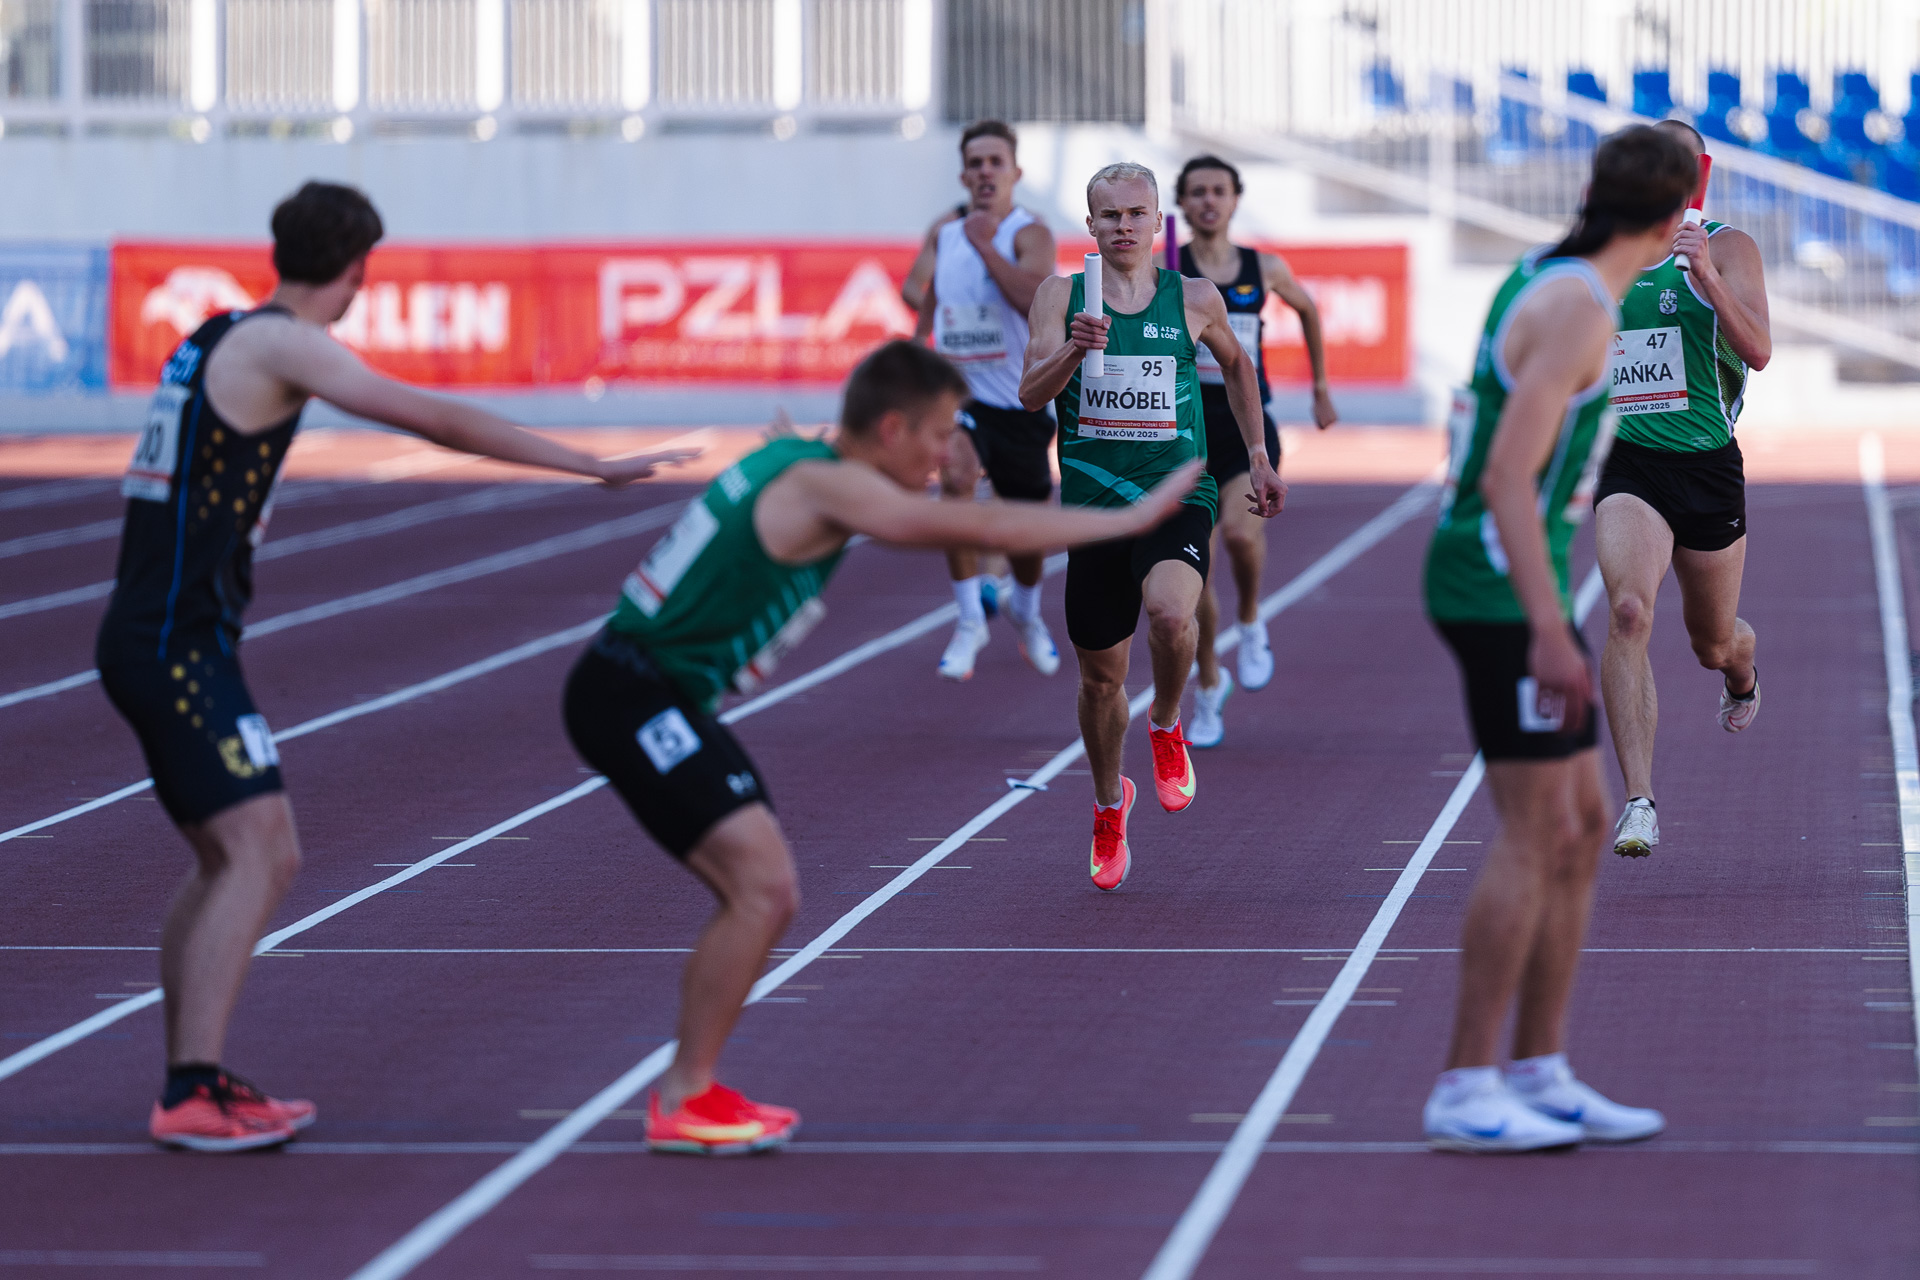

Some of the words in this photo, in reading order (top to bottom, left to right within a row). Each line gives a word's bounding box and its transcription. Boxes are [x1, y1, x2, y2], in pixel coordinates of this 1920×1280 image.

[598, 256, 916, 340] PZLA
[1646, 332, 1668, 350] 47
[1141, 360, 1163, 377] 95
[1613, 361, 1674, 386] BAŃKA
[1085, 387, 1171, 410] WRÓBEL
[1649, 402, 1671, 410] 2025
[1095, 429, 1135, 438] KRAKÓW
